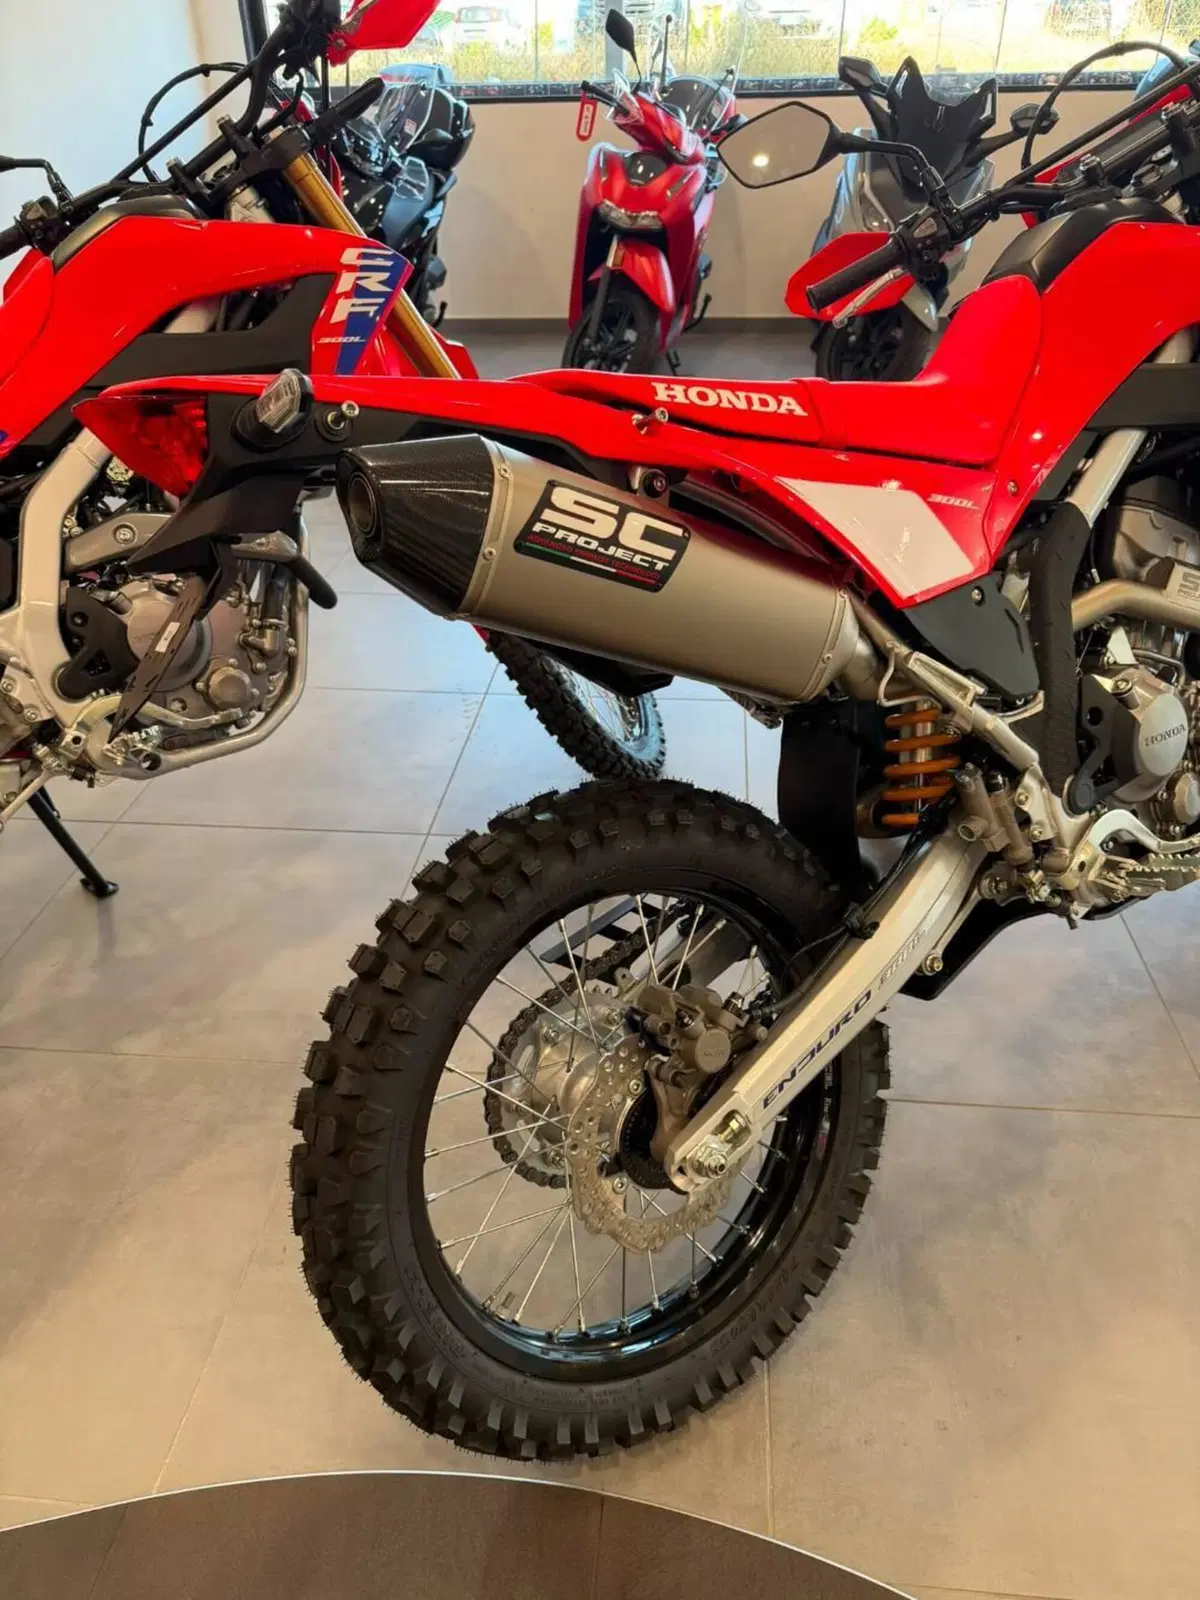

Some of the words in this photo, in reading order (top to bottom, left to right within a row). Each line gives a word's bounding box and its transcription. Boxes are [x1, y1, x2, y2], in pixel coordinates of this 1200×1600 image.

[329, 247, 395, 324] CRF
[651, 382, 808, 416] HONDA
[540, 486, 684, 561] SC
[927, 493, 980, 510] 300L
[532, 522, 669, 571] PROJECT
[1145, 724, 1186, 747] HONDA
[763, 990, 872, 1109] ENDURO
